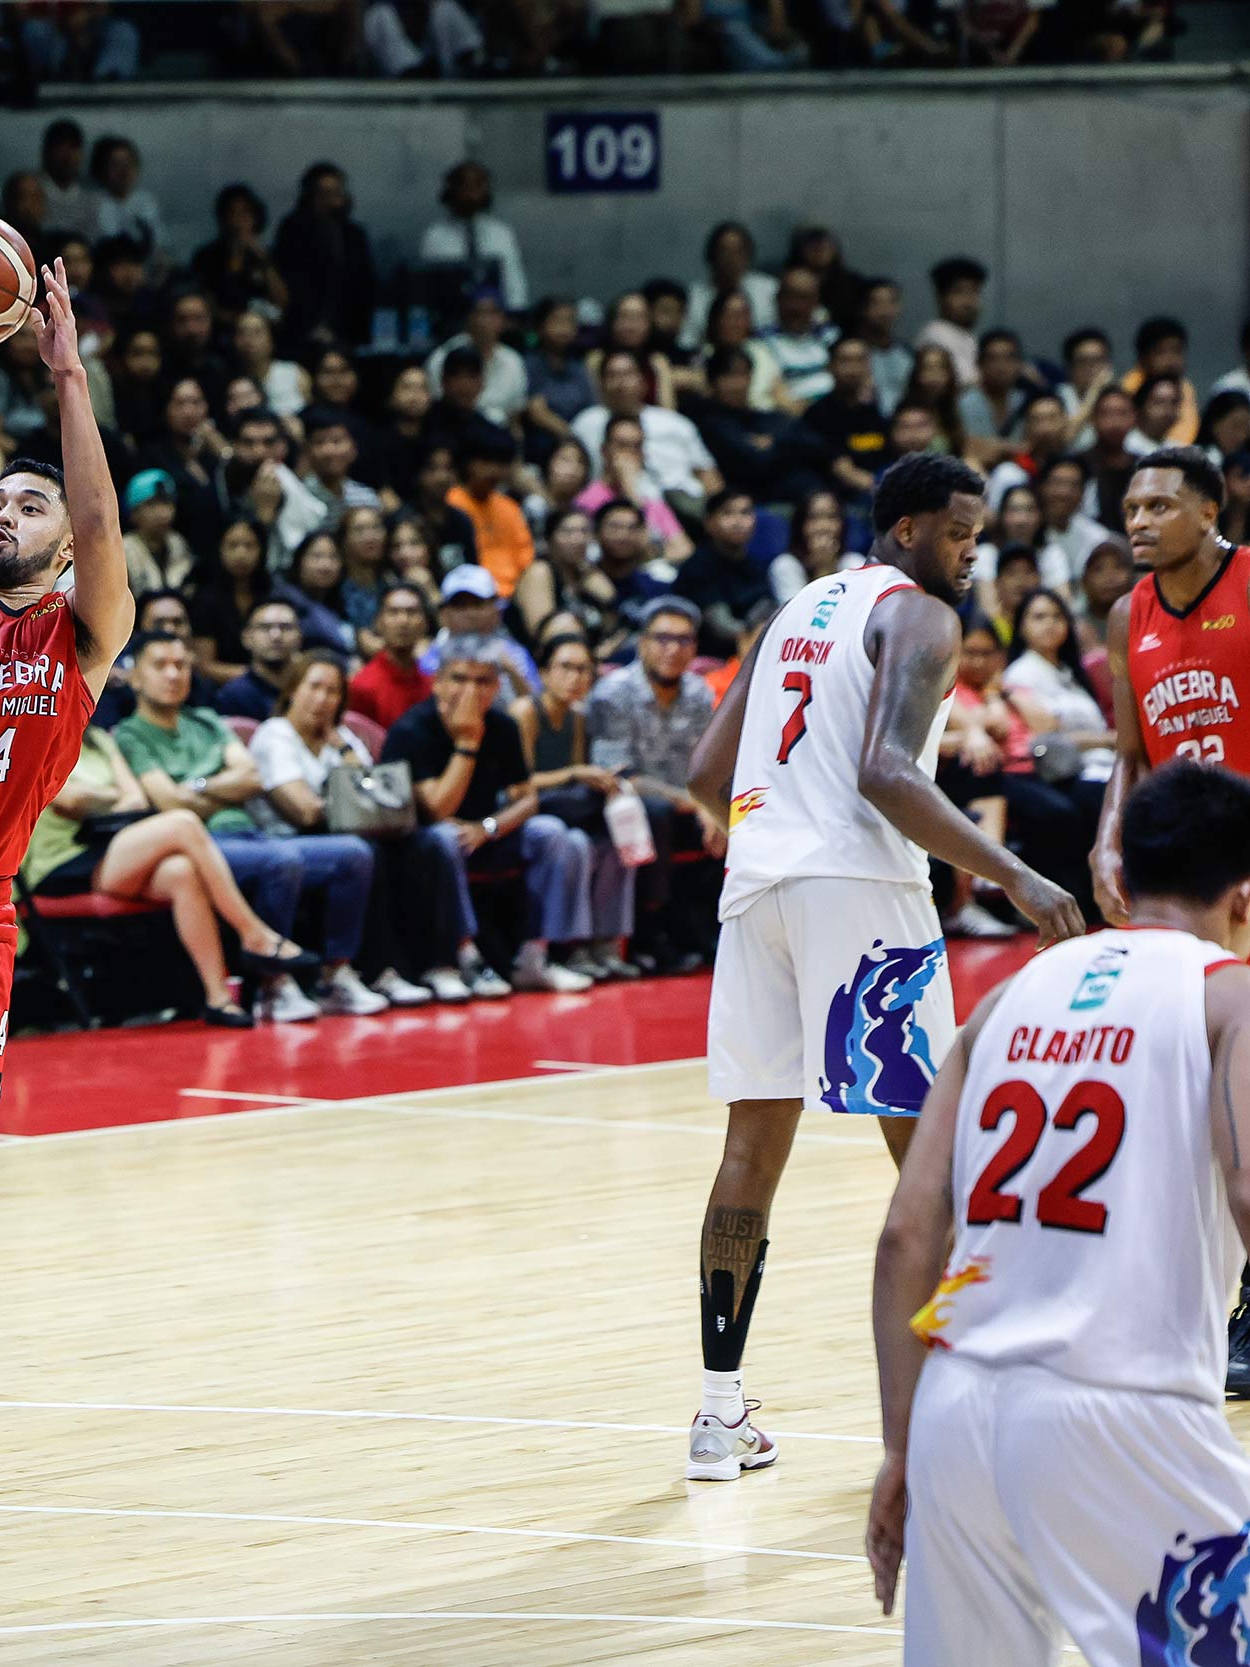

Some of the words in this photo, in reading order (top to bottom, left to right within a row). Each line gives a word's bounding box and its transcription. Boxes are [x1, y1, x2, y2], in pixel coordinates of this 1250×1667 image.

[550, 124, 654, 179] 109
[1, 695, 59, 717] MIGUEL
[776, 671, 814, 766] 7
[1143, 670, 1239, 726] GINEBRA
[1157, 714, 1185, 737] SAN
[1186, 705, 1234, 730] MIGUEL
[967, 1079, 1126, 1236] 22
